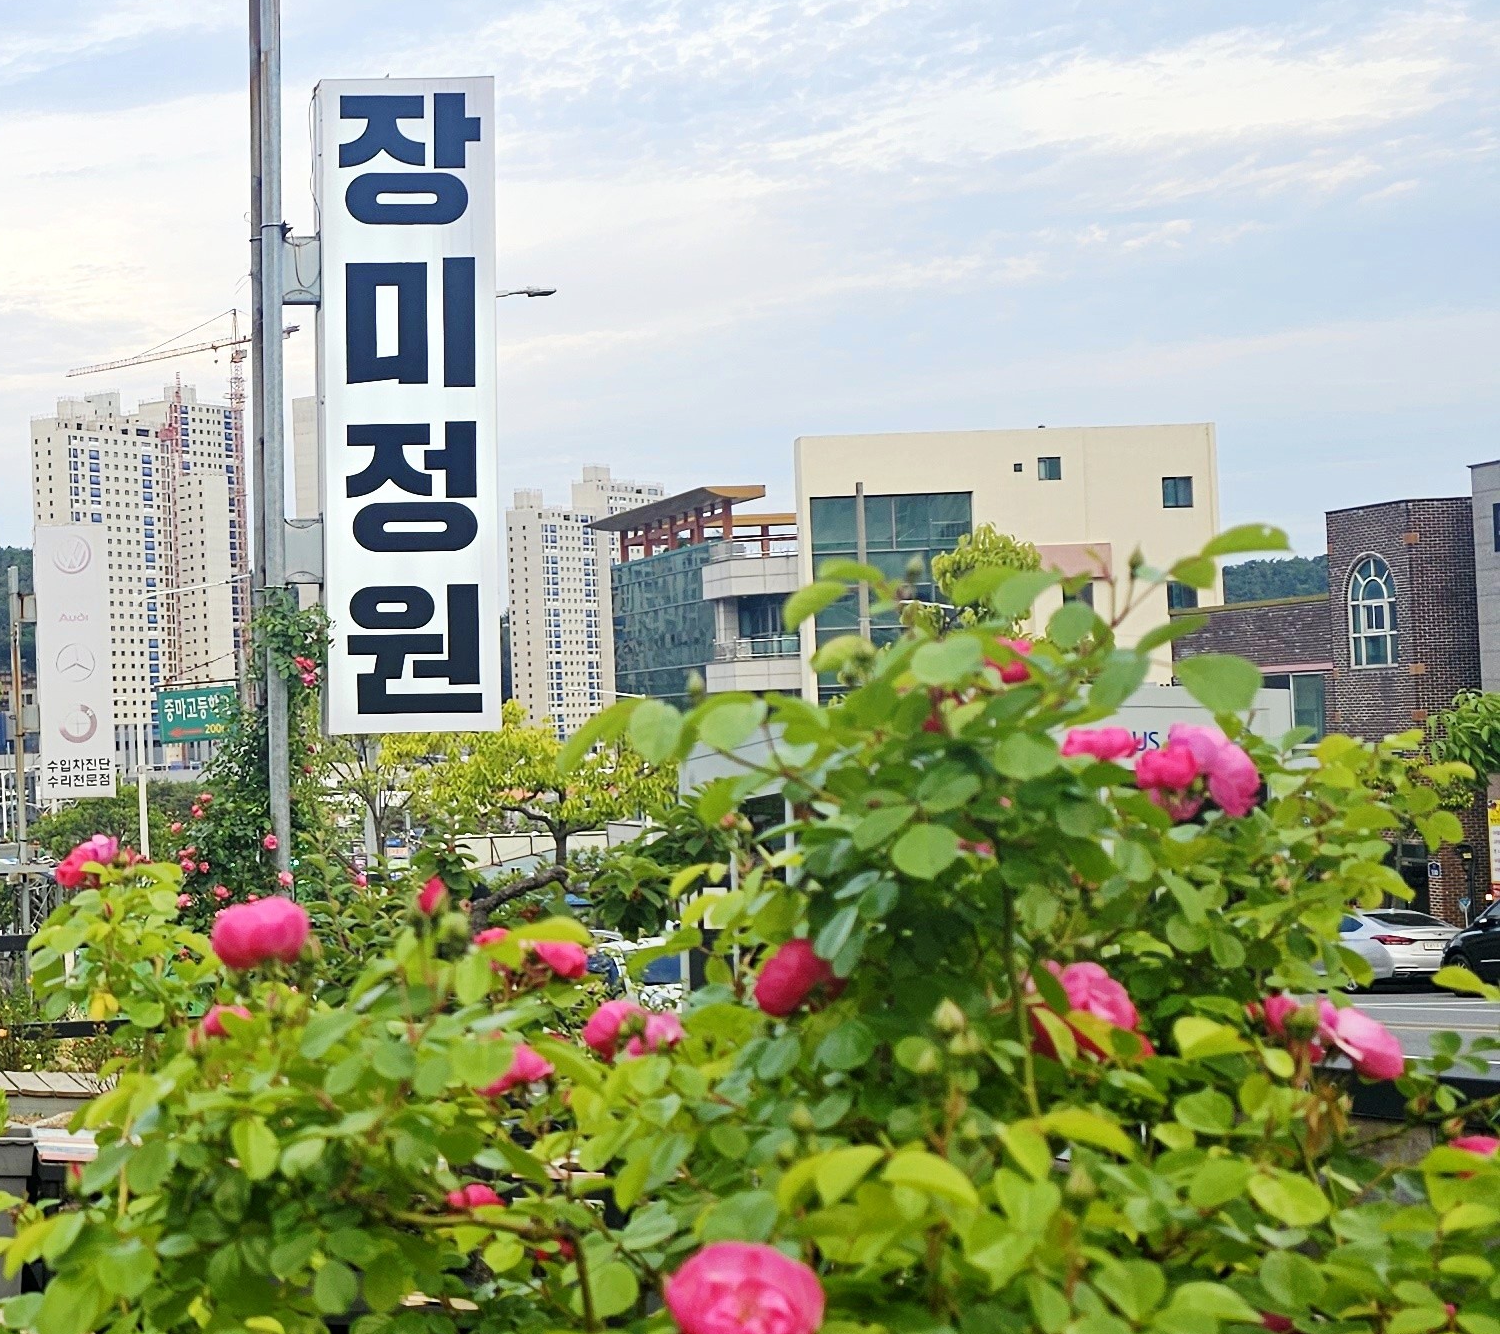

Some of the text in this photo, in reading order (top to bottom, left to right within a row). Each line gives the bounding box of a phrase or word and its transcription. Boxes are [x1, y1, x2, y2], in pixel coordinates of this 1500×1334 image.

[338, 92, 484, 714] 장미정원
[59, 613, 89, 622] Audi
[204, 723, 230, 734] 200
[47, 758, 111, 773] 수입차진단
[47, 773, 111, 788] 수리전문점
